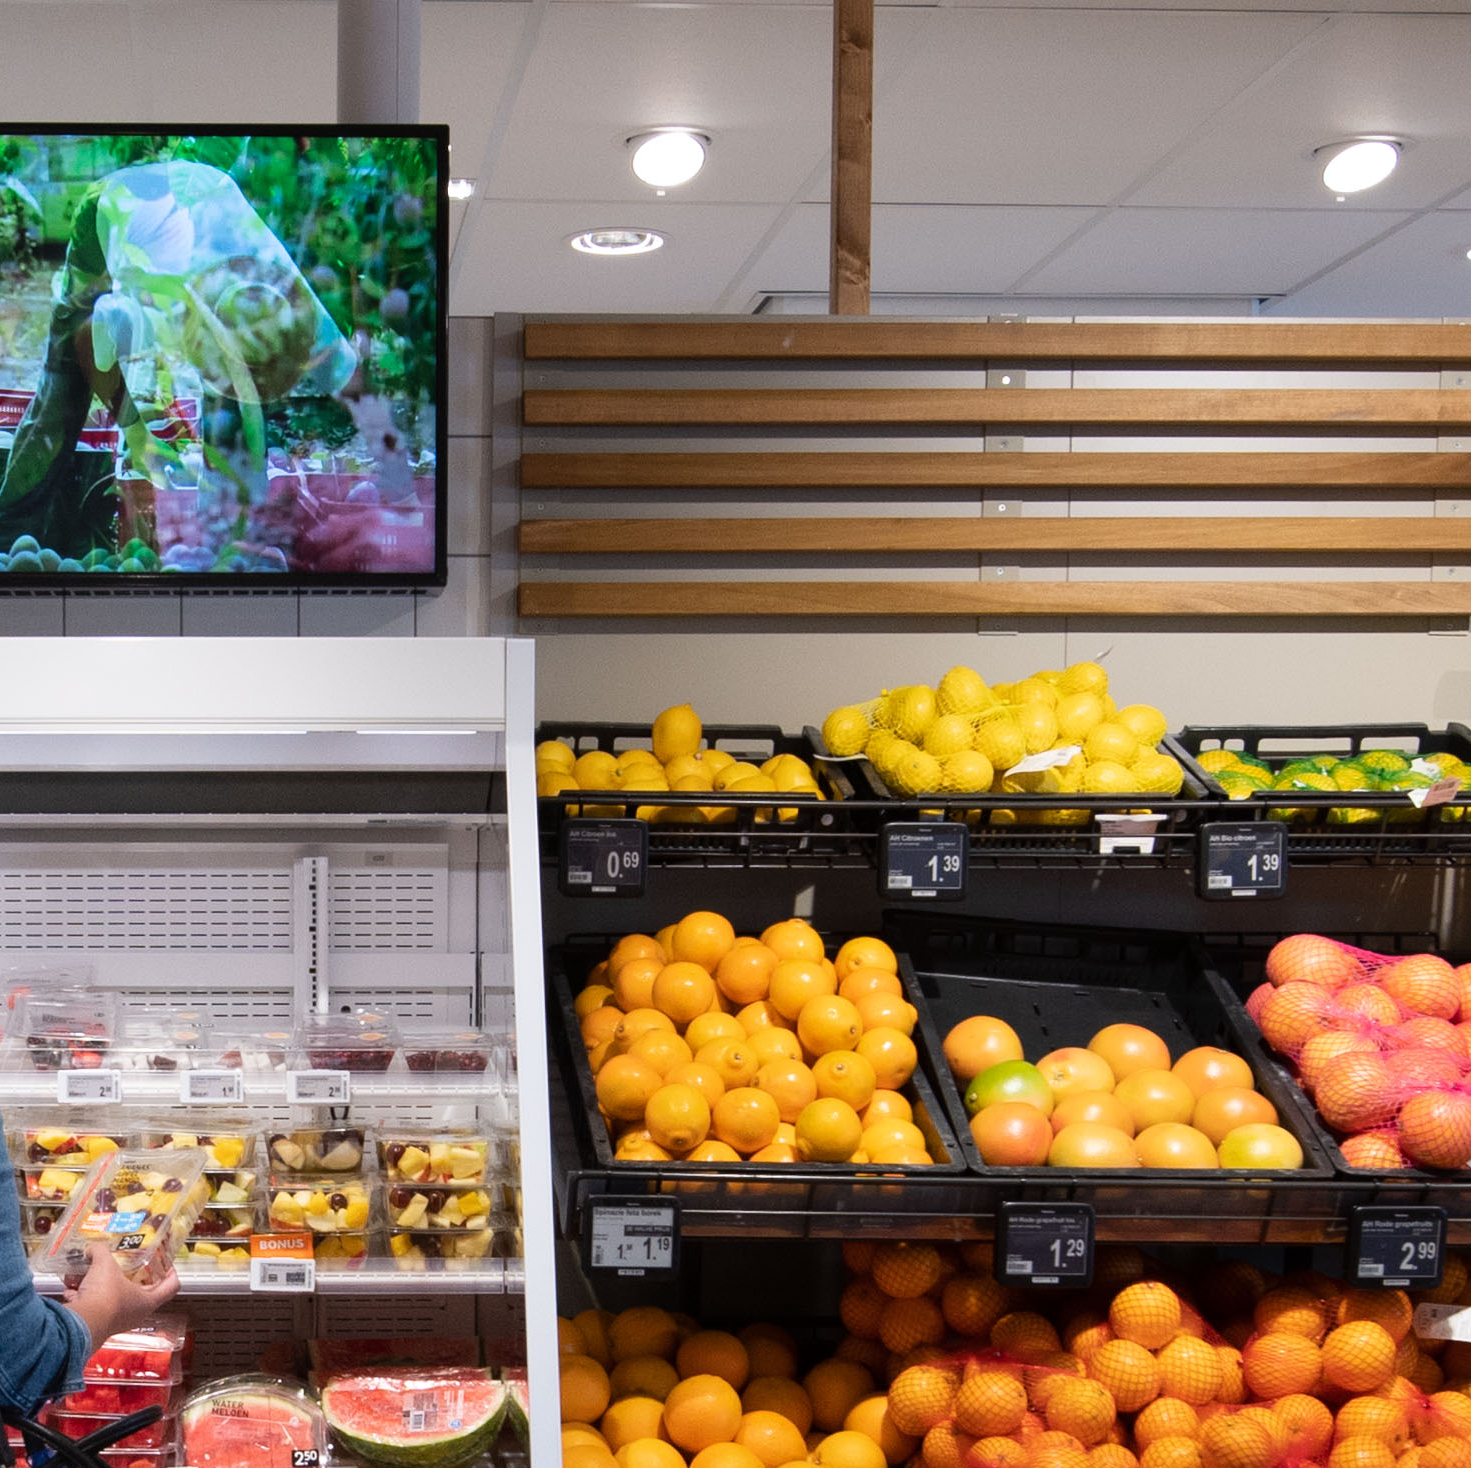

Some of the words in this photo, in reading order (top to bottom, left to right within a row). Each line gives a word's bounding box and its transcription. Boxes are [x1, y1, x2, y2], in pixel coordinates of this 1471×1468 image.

[607, 851, 640, 878] 0.69
[927, 854, 960, 882] 1.39
[1247, 854, 1280, 881] 1.39
[259, 1239, 304, 1251] BONUS
[643, 1237, 670, 1260] 1.19
[1050, 1239, 1085, 1267] 1.29
[1399, 1242, 1436, 1270] 2.99
[212, 1399, 244, 1409] WATER
[294, 1450, 318, 1467] 2.50
